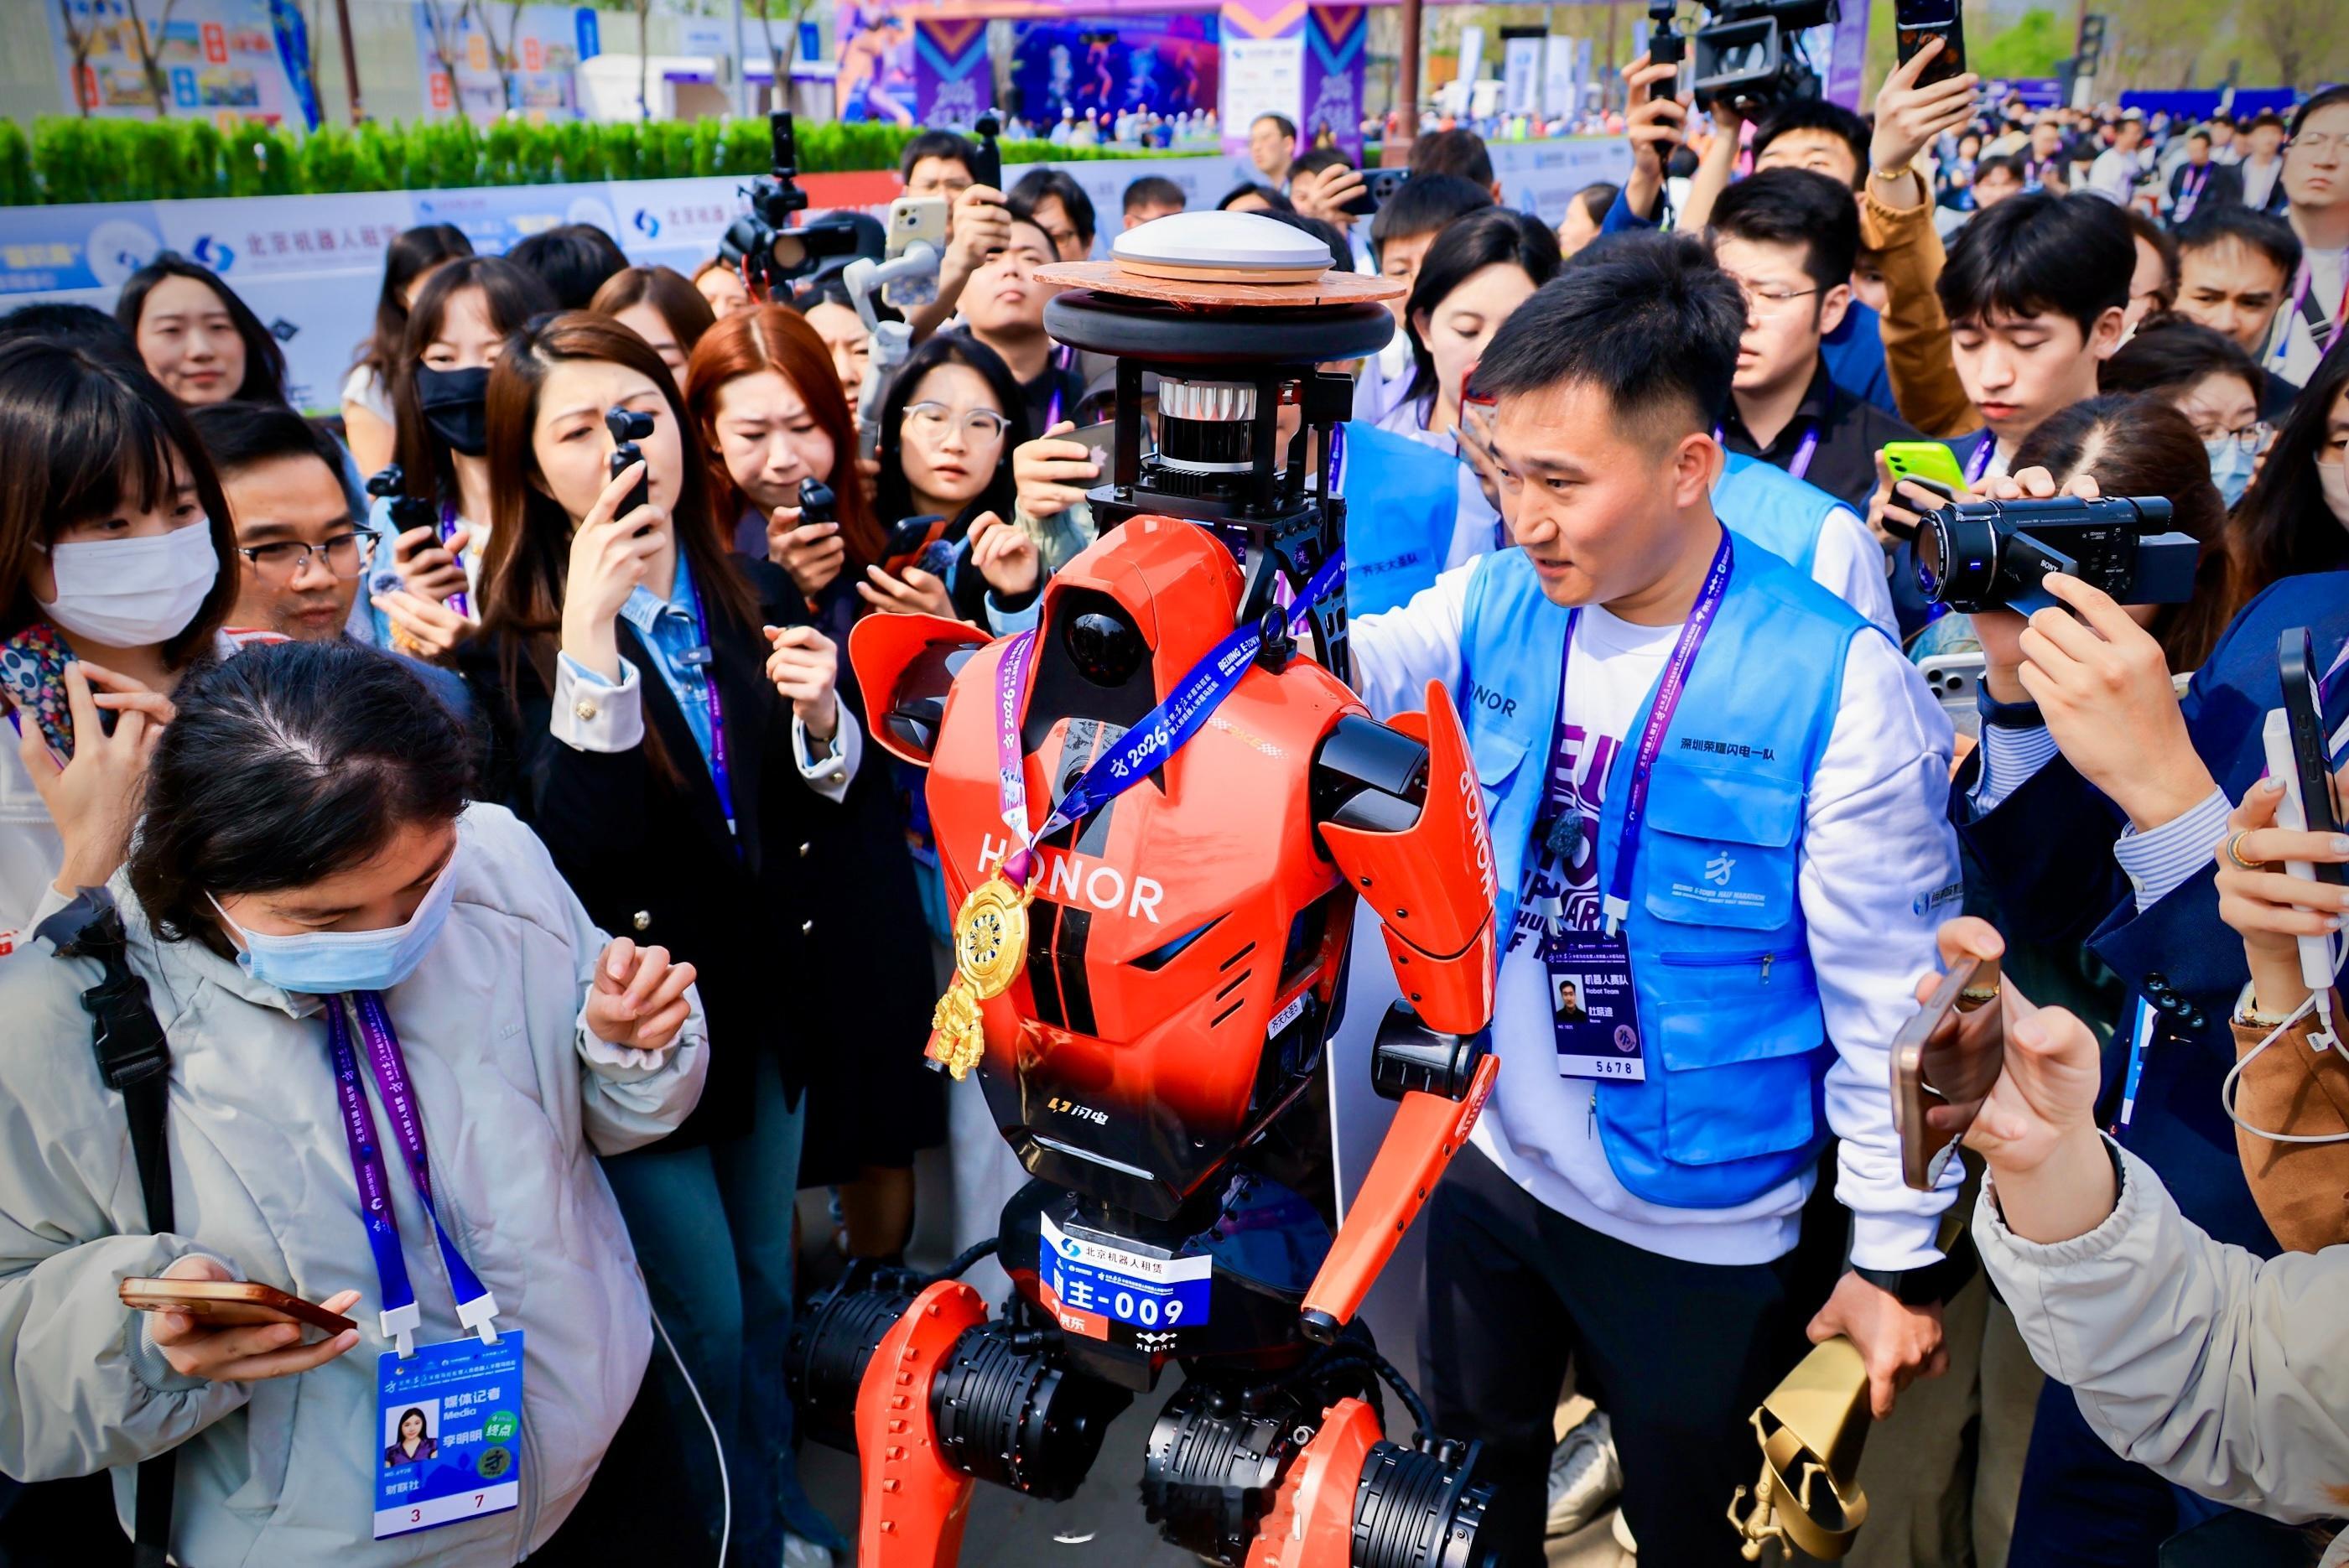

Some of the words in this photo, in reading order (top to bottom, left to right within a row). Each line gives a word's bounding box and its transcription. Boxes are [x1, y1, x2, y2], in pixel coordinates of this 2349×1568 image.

[1361, 552, 1420, 578] 齐天大圣队
[2040, 559, 2059, 573] SONY
[1218, 647, 1242, 672] BEIJING
[1003, 688, 1016, 729] 2026
[1127, 724, 1168, 769] 2026
[1681, 738, 1775, 761] 深圳荣耀闪电一队
[1460, 771, 1494, 896] HONOR
[1584, 974, 1629, 985] 机器人赛队
[1070, 1105, 1109, 1125] 闪电
[1086, 1246, 1163, 1275] 北京机器人租赁
[444, 1387, 501, 1410] 媒体记者
[444, 1408, 476, 1420] Media
[443, 1429, 482, 1448] 李明明
[486, 1424, 512, 1437] 终点
[386, 1480, 419, 1496] 财联社
[475, 1494, 484, 1508] 7
[411, 1509, 421, 1522] 3
